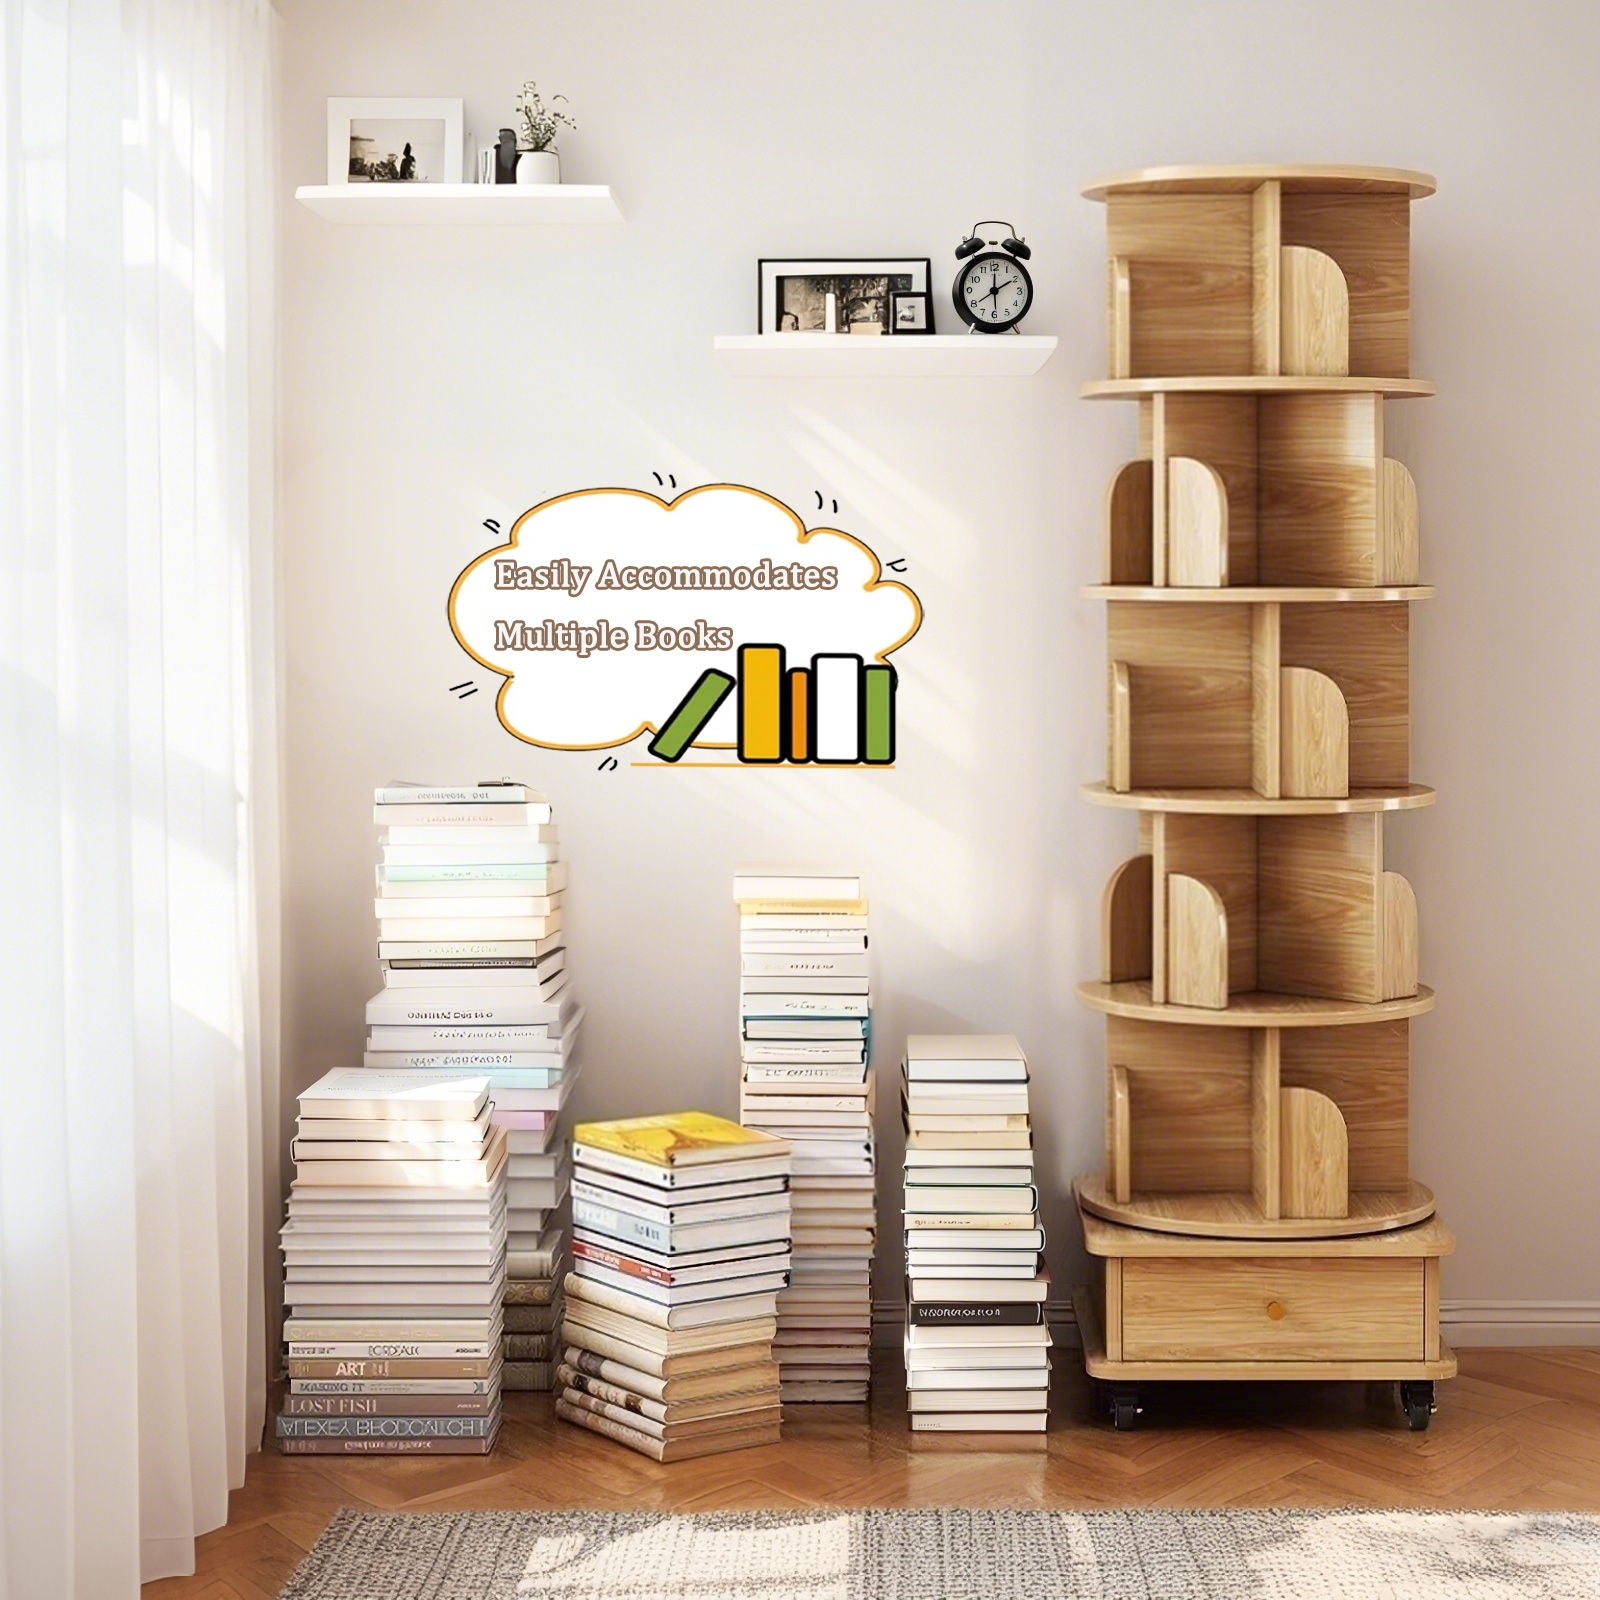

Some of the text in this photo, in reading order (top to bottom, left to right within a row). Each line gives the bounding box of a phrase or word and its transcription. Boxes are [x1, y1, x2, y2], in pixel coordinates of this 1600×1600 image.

[990, 262, 1000, 272] 12
[1012, 275, 1018, 283] 2
[1016, 287, 1023, 295] 3
[970, 300, 978, 308] 8
[980, 308, 986, 316] 7
[991, 310, 998, 319] 6
[1004, 308, 1010, 316] 5
[335, 1362, 367, 1376] ART
[290, 1399, 377, 1413] LOST FISH
